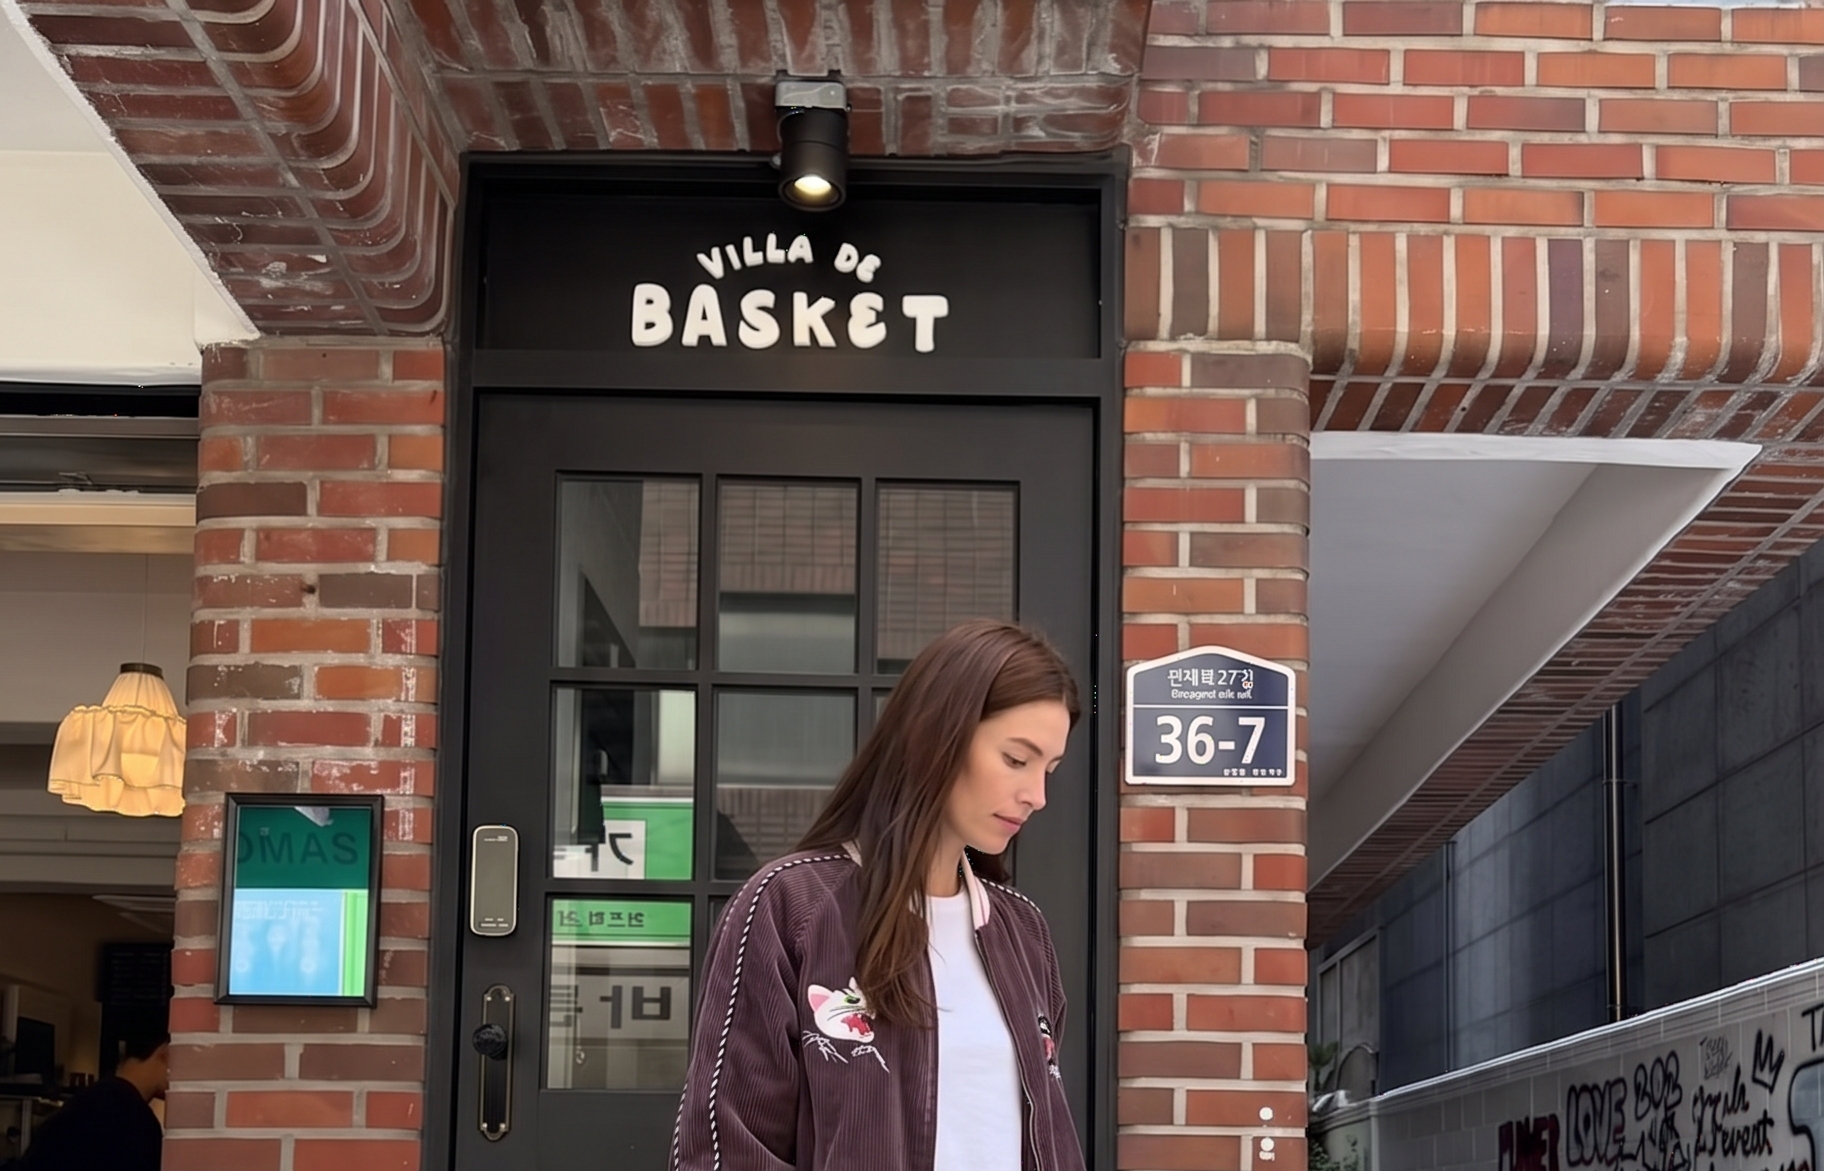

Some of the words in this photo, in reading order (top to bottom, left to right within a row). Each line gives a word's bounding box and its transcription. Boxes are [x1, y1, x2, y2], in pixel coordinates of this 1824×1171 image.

[696, 232, 814, 279] VILLA
[834, 242, 882, 283] DE
[631, 282, 949, 353] BASKET
[1155, 715, 1266, 765] 36-7
[1566, 1077, 1628, 1168] LOVE
[1634, 1050, 1683, 1122] BOB
